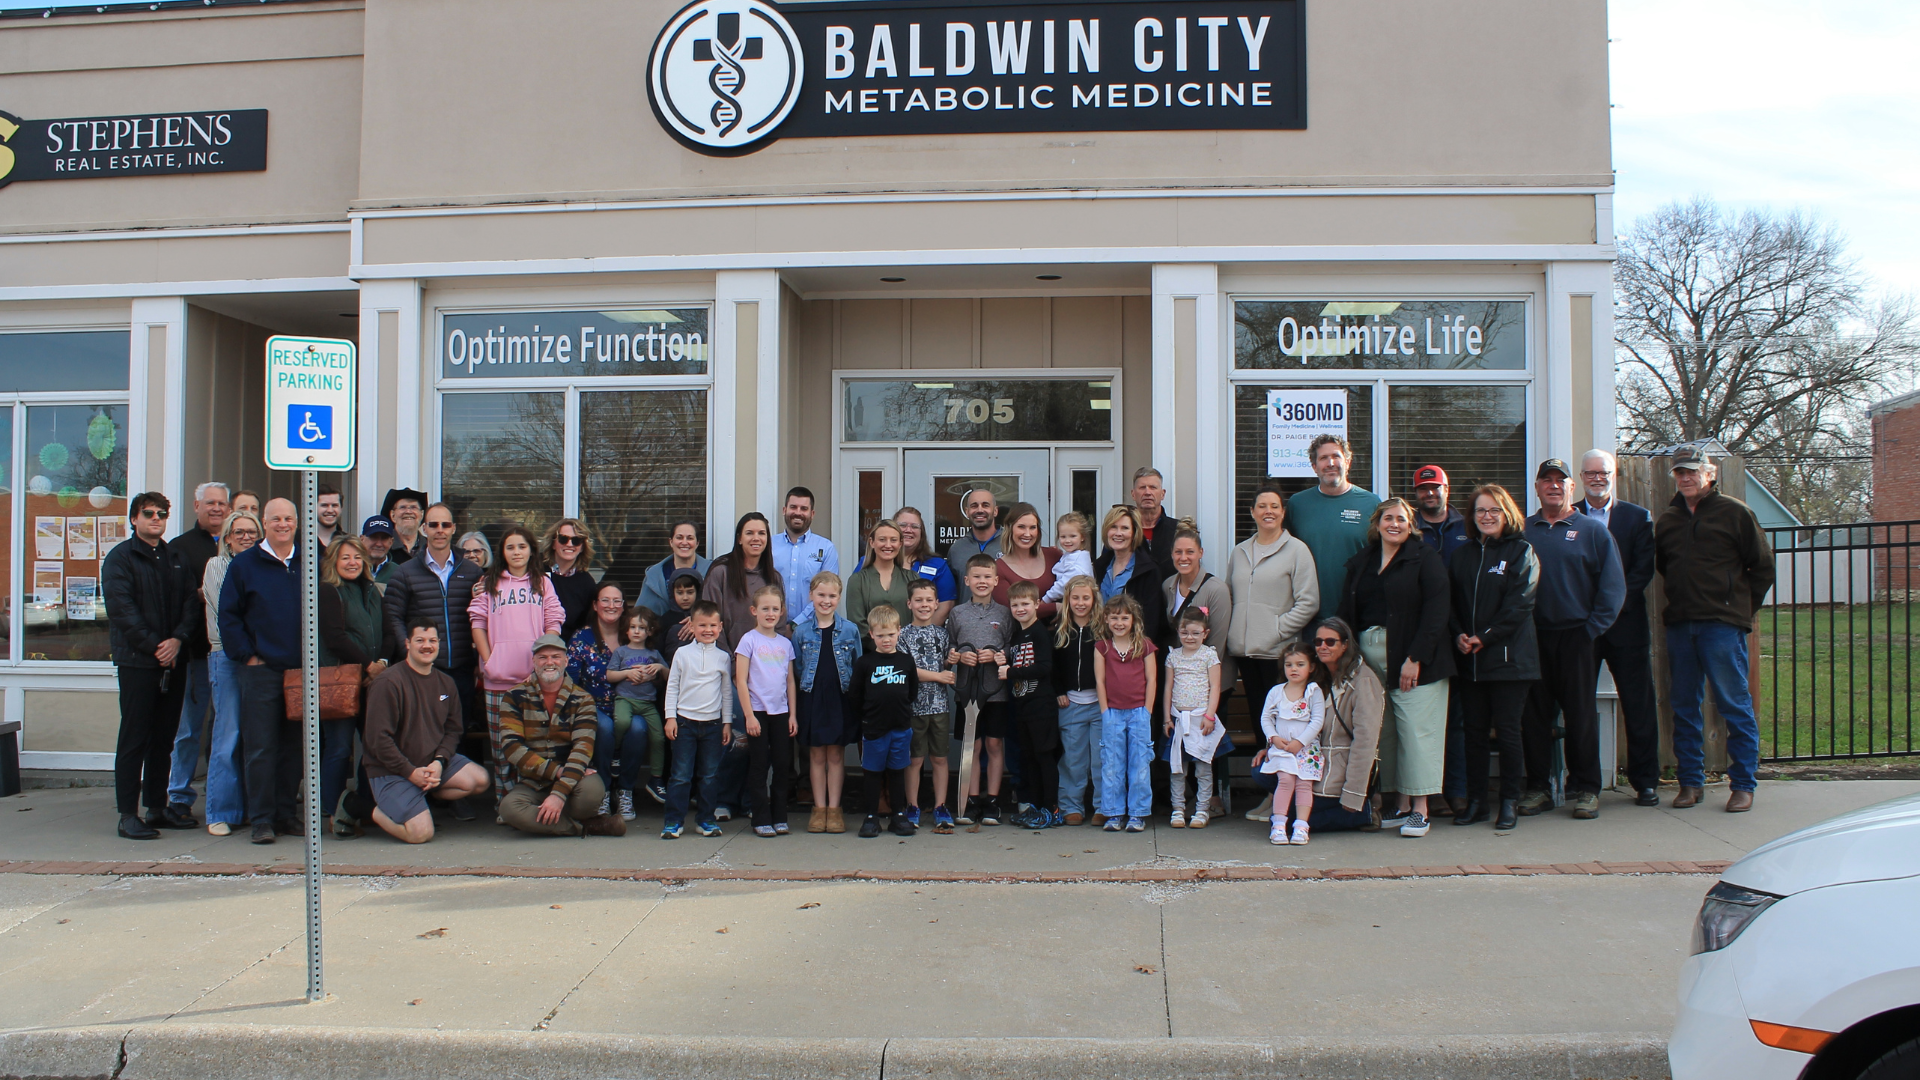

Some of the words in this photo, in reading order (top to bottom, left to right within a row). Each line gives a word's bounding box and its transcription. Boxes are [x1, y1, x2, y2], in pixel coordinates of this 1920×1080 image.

[825, 19, 1100, 79] BALDWIN
[1133, 16, 1272, 73] CITY
[824, 85, 1055, 114] METABOLIC
[1071, 82, 1273, 108] MEDICINE
[46, 114, 232, 154] STEPHENS
[55, 157, 101, 172] REAL
[109, 153, 182, 169] ESTATE,
[188, 151, 224, 165] INC.
[449, 324, 572, 374] Optimize
[580, 322, 702, 363] Function
[1278, 314, 1416, 365] Optimize
[1425, 314, 1484, 356] Life
[273, 349, 348, 369] RESERVED
[278, 371, 343, 391] PARKING
[943, 398, 1015, 424] 705
[874, 665, 894, 675] JUST
